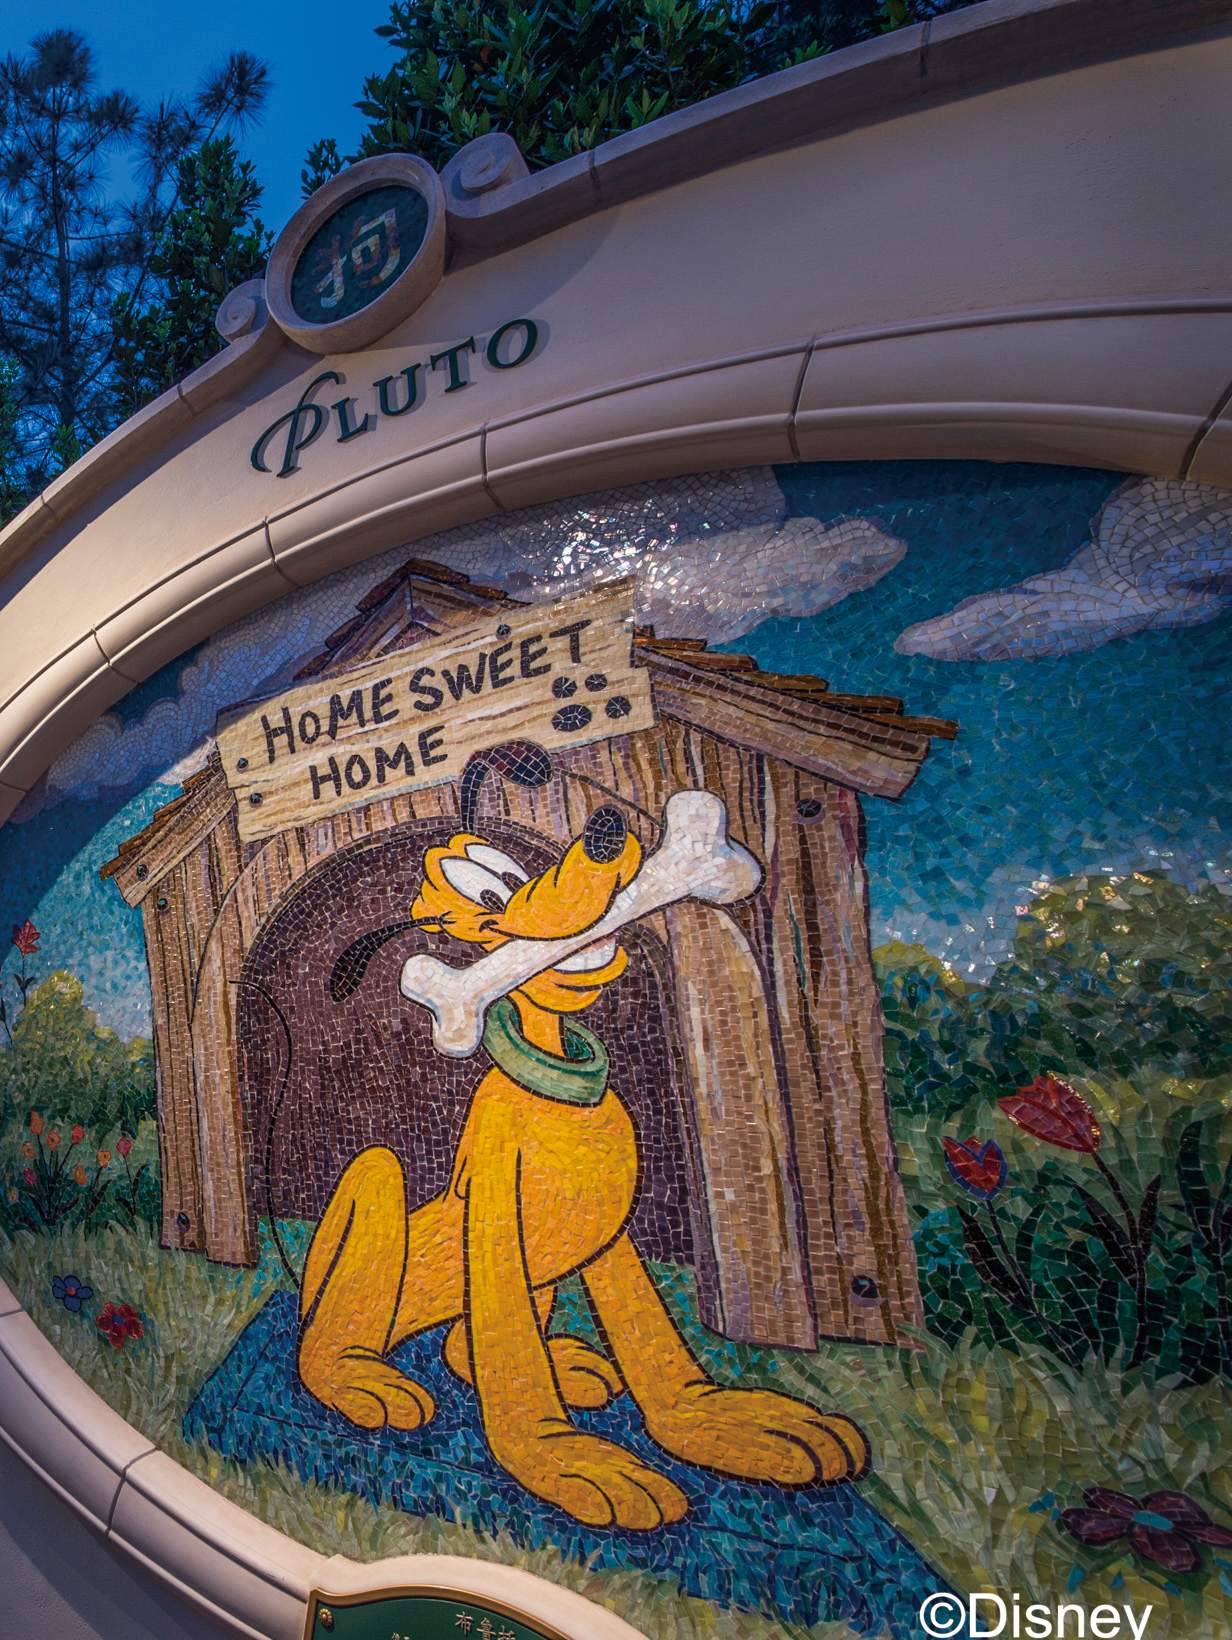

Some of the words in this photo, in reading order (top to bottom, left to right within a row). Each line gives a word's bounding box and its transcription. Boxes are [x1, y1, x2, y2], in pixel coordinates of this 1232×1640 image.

[250, 318, 538, 478] PLUTO
[260, 679, 400, 764] HOME
[410, 618, 593, 712] SWEET
[309, 725, 448, 800] HOME
